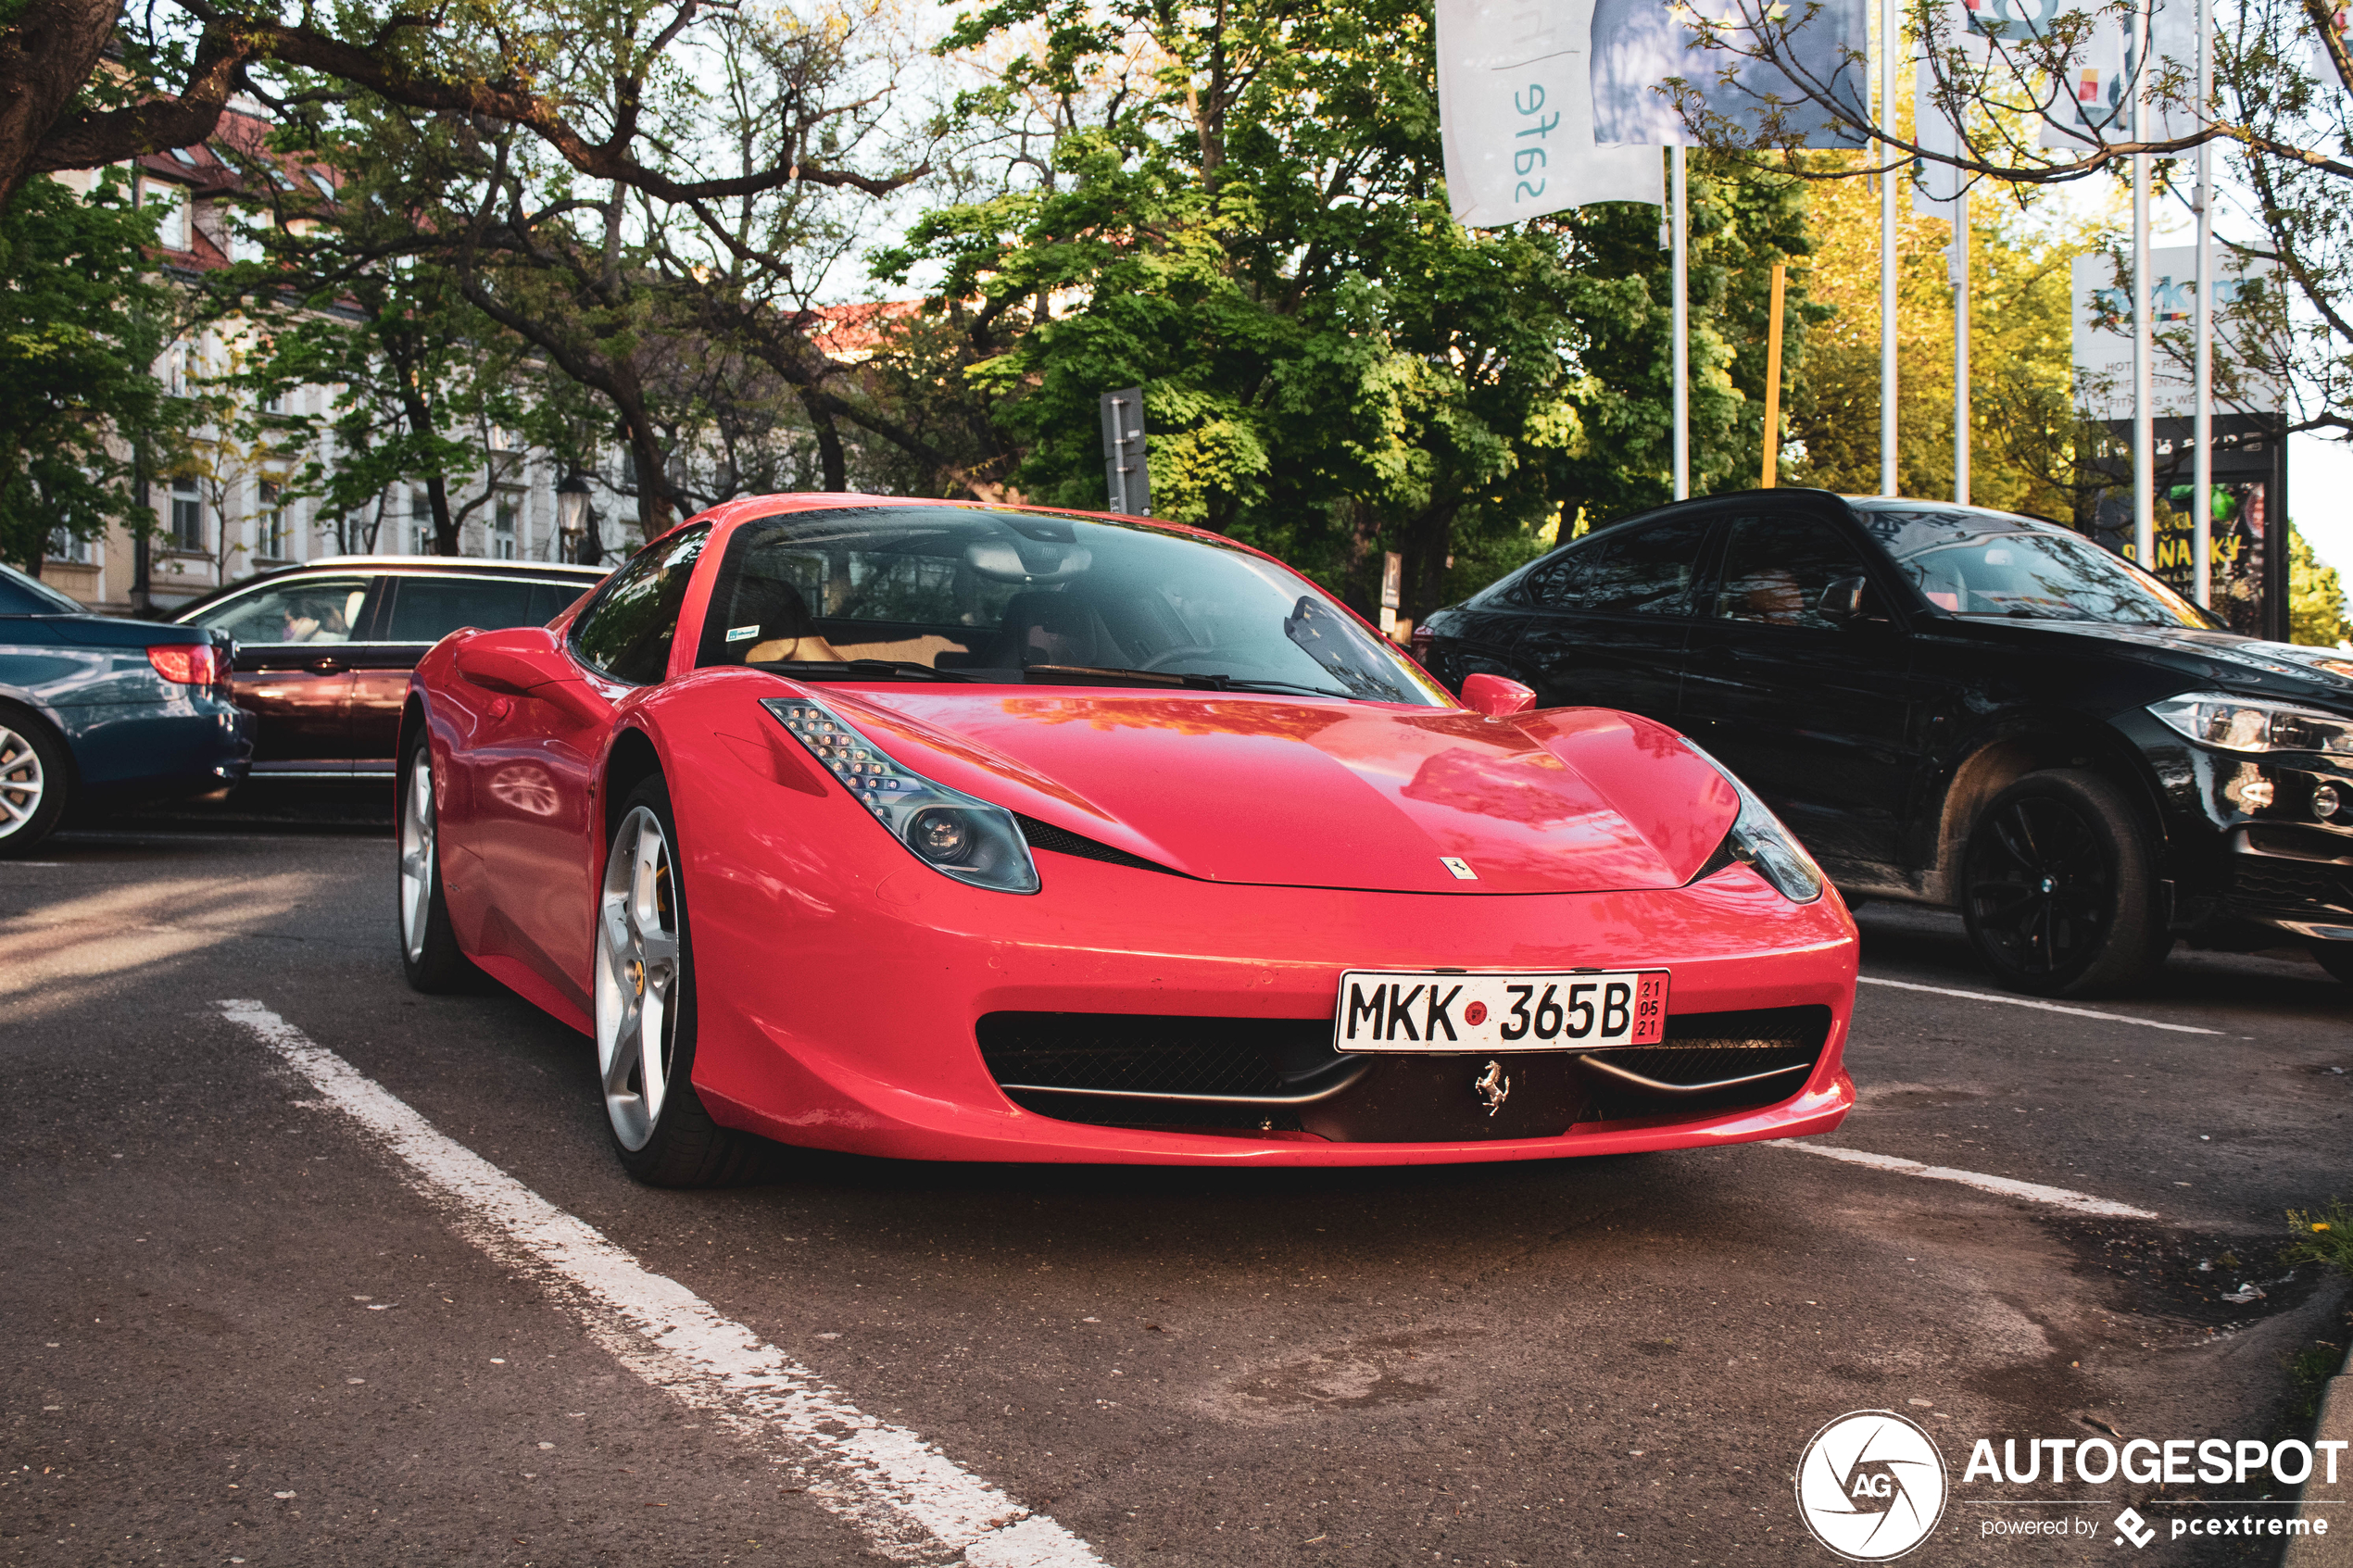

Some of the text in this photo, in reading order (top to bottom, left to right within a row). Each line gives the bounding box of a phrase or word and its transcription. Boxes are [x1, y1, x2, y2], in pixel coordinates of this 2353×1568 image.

[1642, 980, 1659, 997] 21
[1346, 983, 1463, 1041] MKK
[1500, 982, 1631, 1040] 365B
[1640, 999, 1658, 1016] 05
[1637, 1019, 1655, 1036] 21
